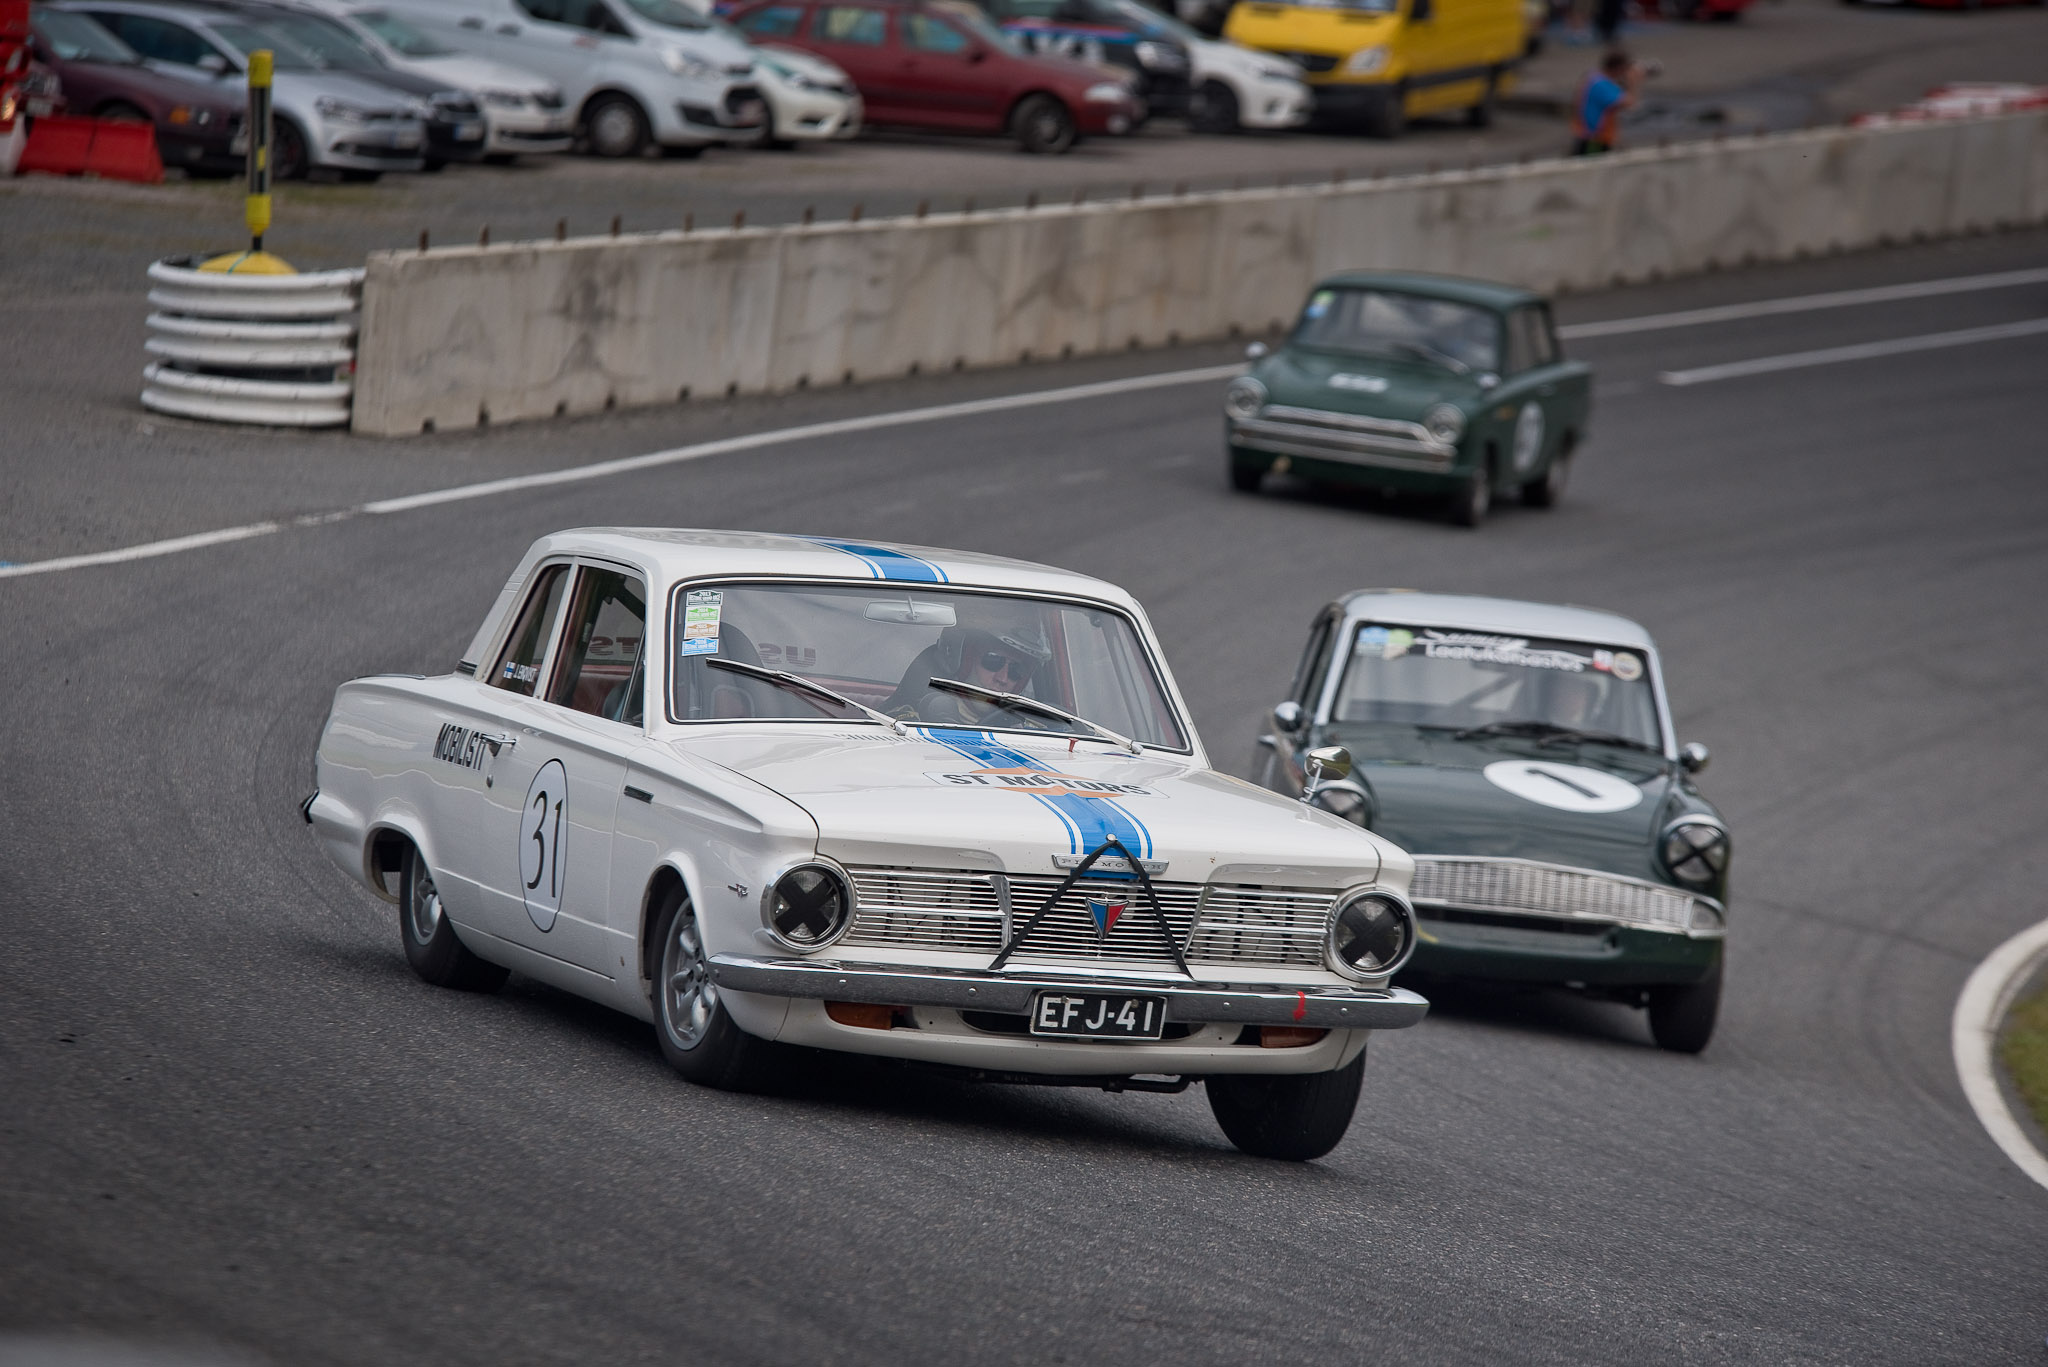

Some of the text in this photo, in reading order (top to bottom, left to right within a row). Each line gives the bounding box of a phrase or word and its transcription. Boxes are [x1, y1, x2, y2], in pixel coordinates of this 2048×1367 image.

[942, 773, 1152, 796] ST MOTORS
[1526, 768, 1602, 799] 1
[527, 790, 564, 898] 31
[1039, 996, 1154, 1032] EFJ-41
